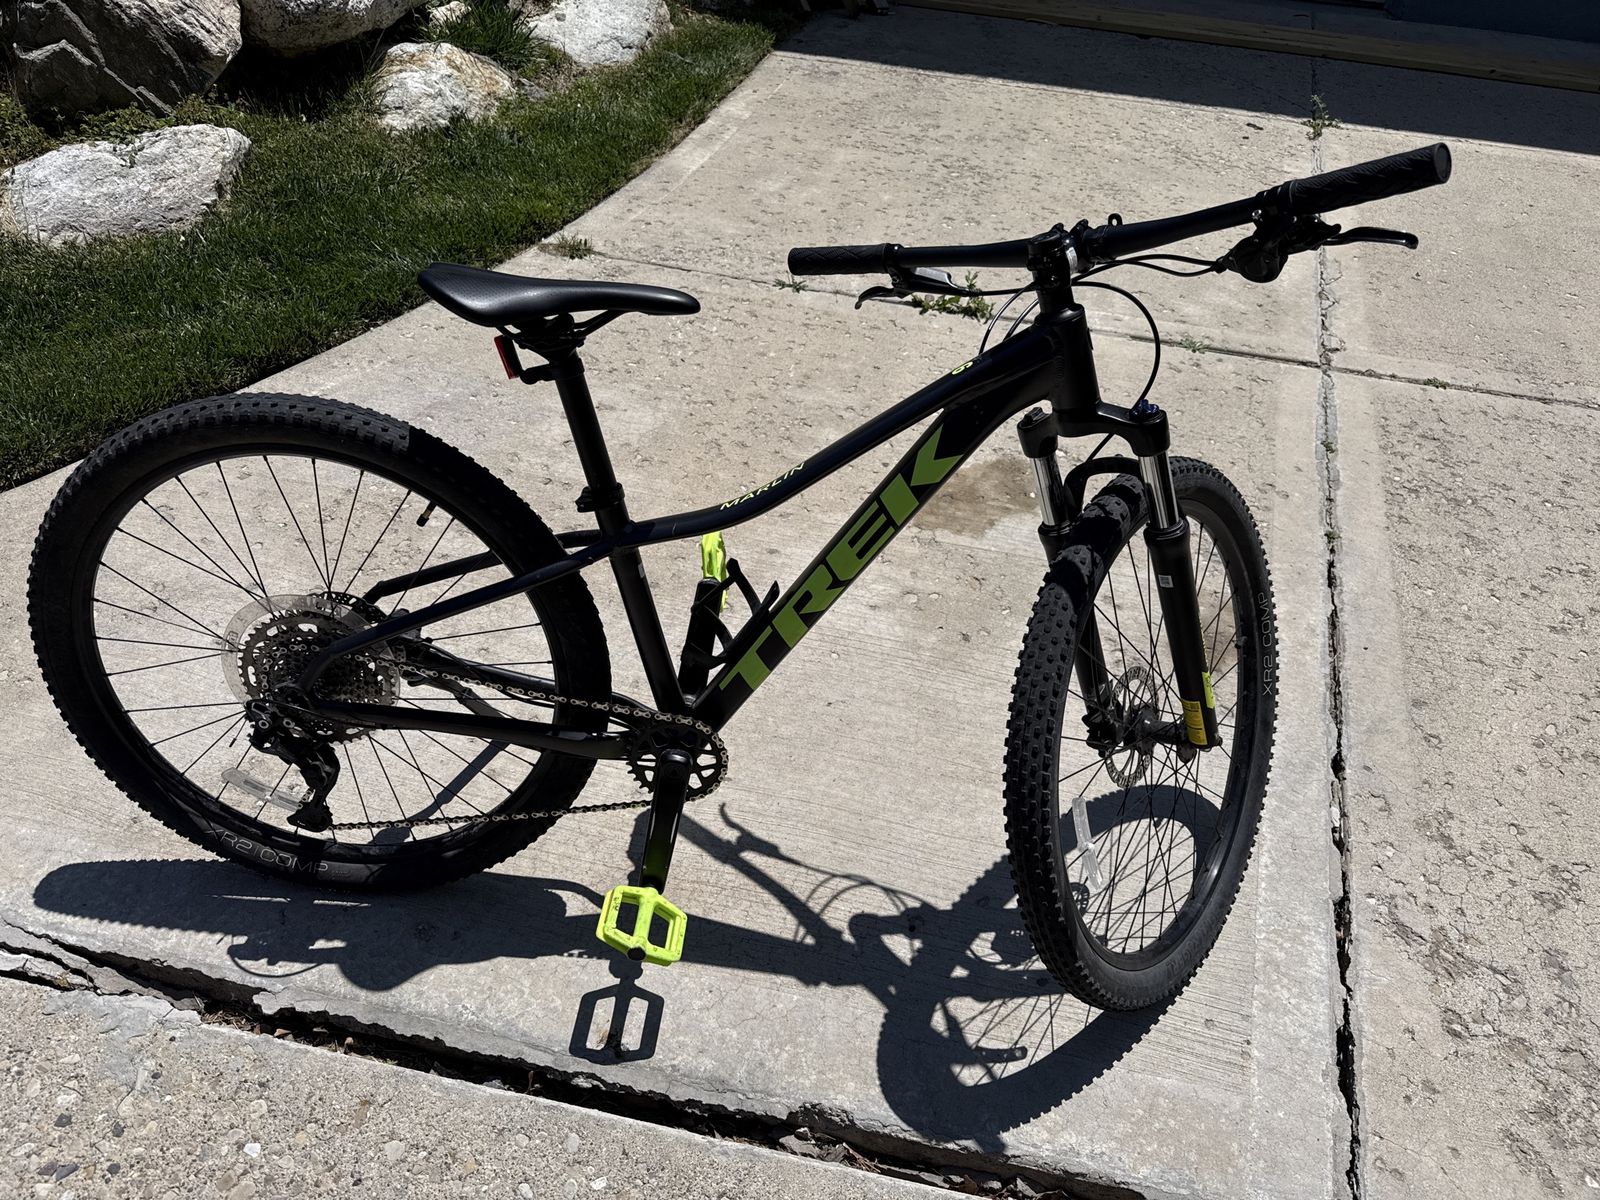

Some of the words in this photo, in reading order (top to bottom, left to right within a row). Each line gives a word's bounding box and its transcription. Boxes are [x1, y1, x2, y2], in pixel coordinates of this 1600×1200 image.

[718, 462, 805, 511] MARLIN
[718, 423, 965, 692] TREK
[1256, 592, 1272, 648] COMP
[1262, 654, 1273, 697] XR2
[259, 848, 329, 875] COMP
